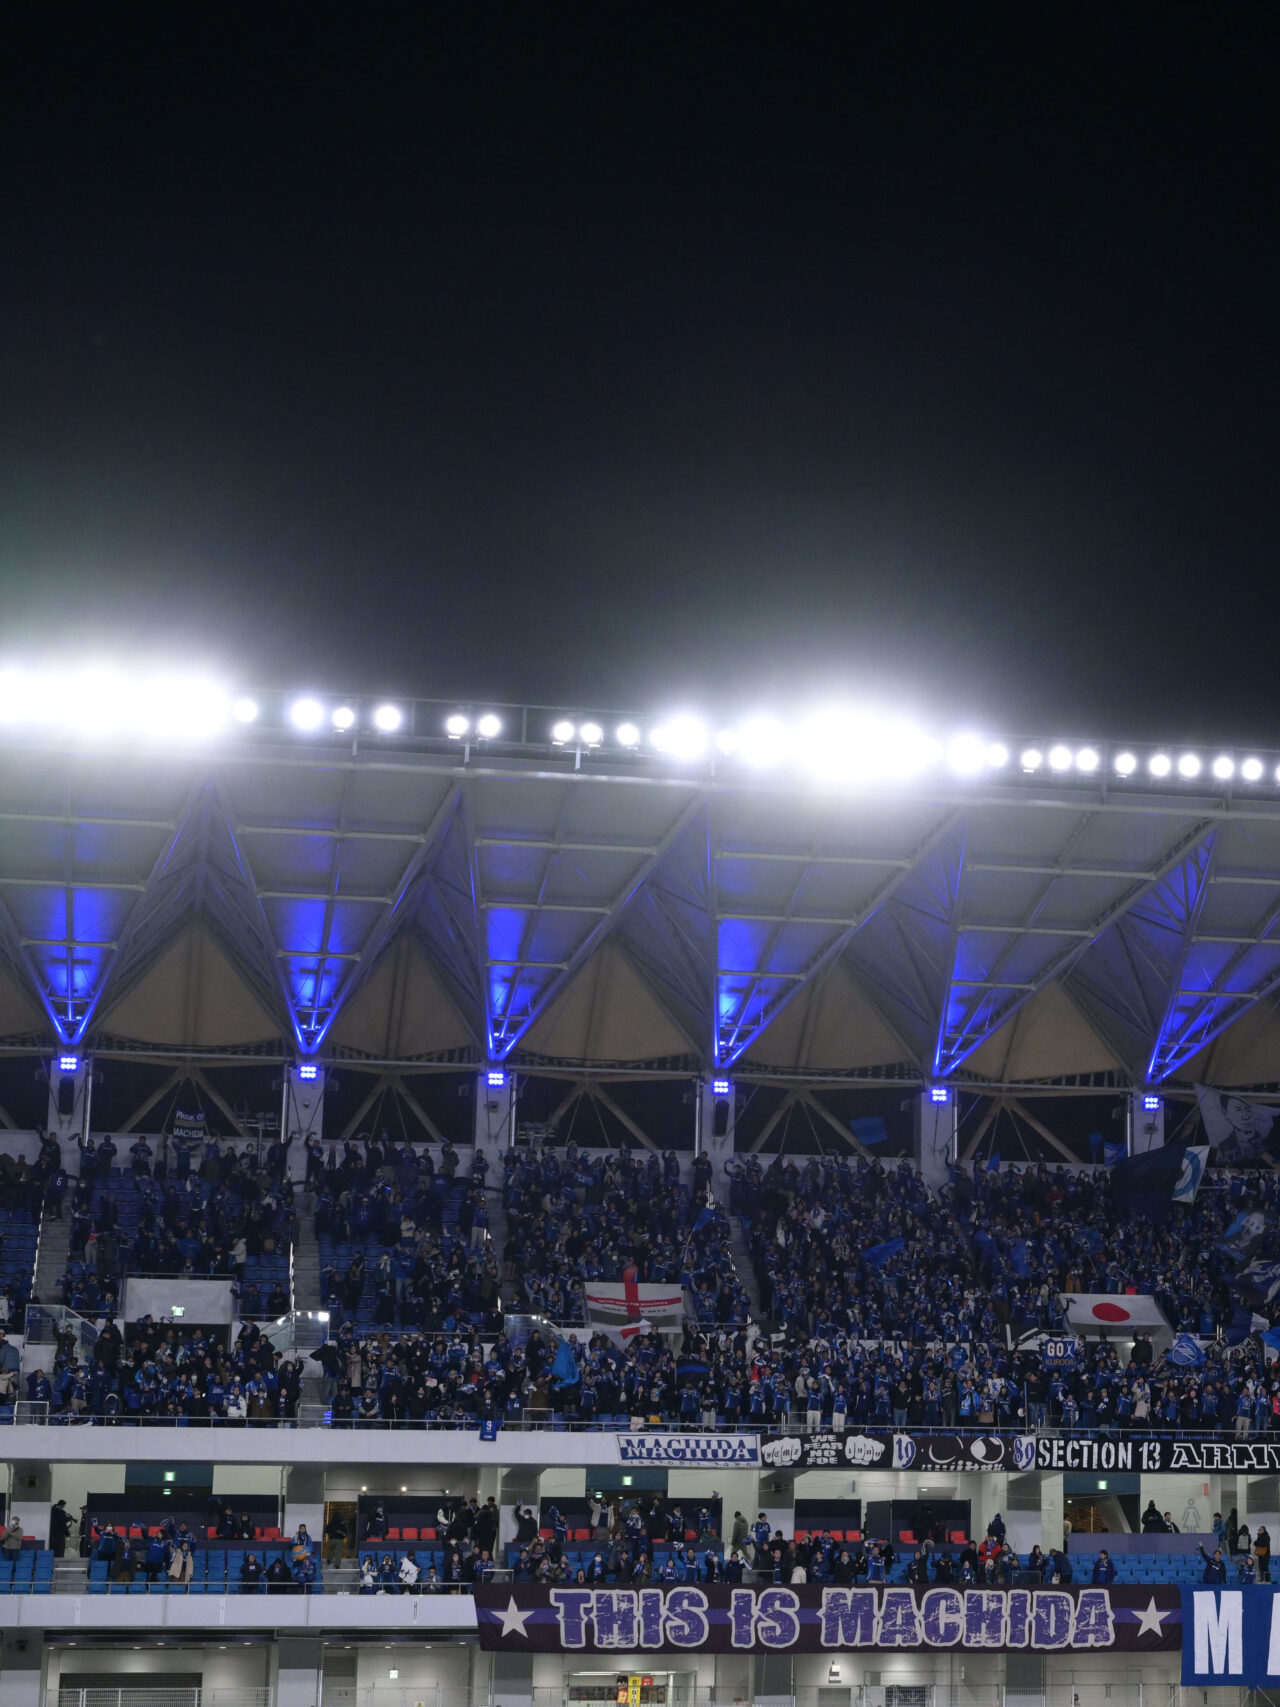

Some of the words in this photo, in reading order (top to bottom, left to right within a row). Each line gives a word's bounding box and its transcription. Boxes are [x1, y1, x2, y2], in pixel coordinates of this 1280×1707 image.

[173, 1127, 204, 1138] MACHIDA
[1047, 1342, 1065, 1357] GO
[1045, 1358, 1075, 1367] KURODA
[486, 1420, 492, 1431] 9
[624, 1438, 753, 1460] MACHIDA
[803, 1442, 843, 1451] FEAR
[1038, 1438, 1133, 1470] SECTION
[1138, 1441, 1161, 1470] 13
[806, 1457, 838, 1466] FOE
[550, 1587, 709, 1648] THIS
[727, 1587, 800, 1648] IS
[816, 1587, 1116, 1649] MACHIDA
